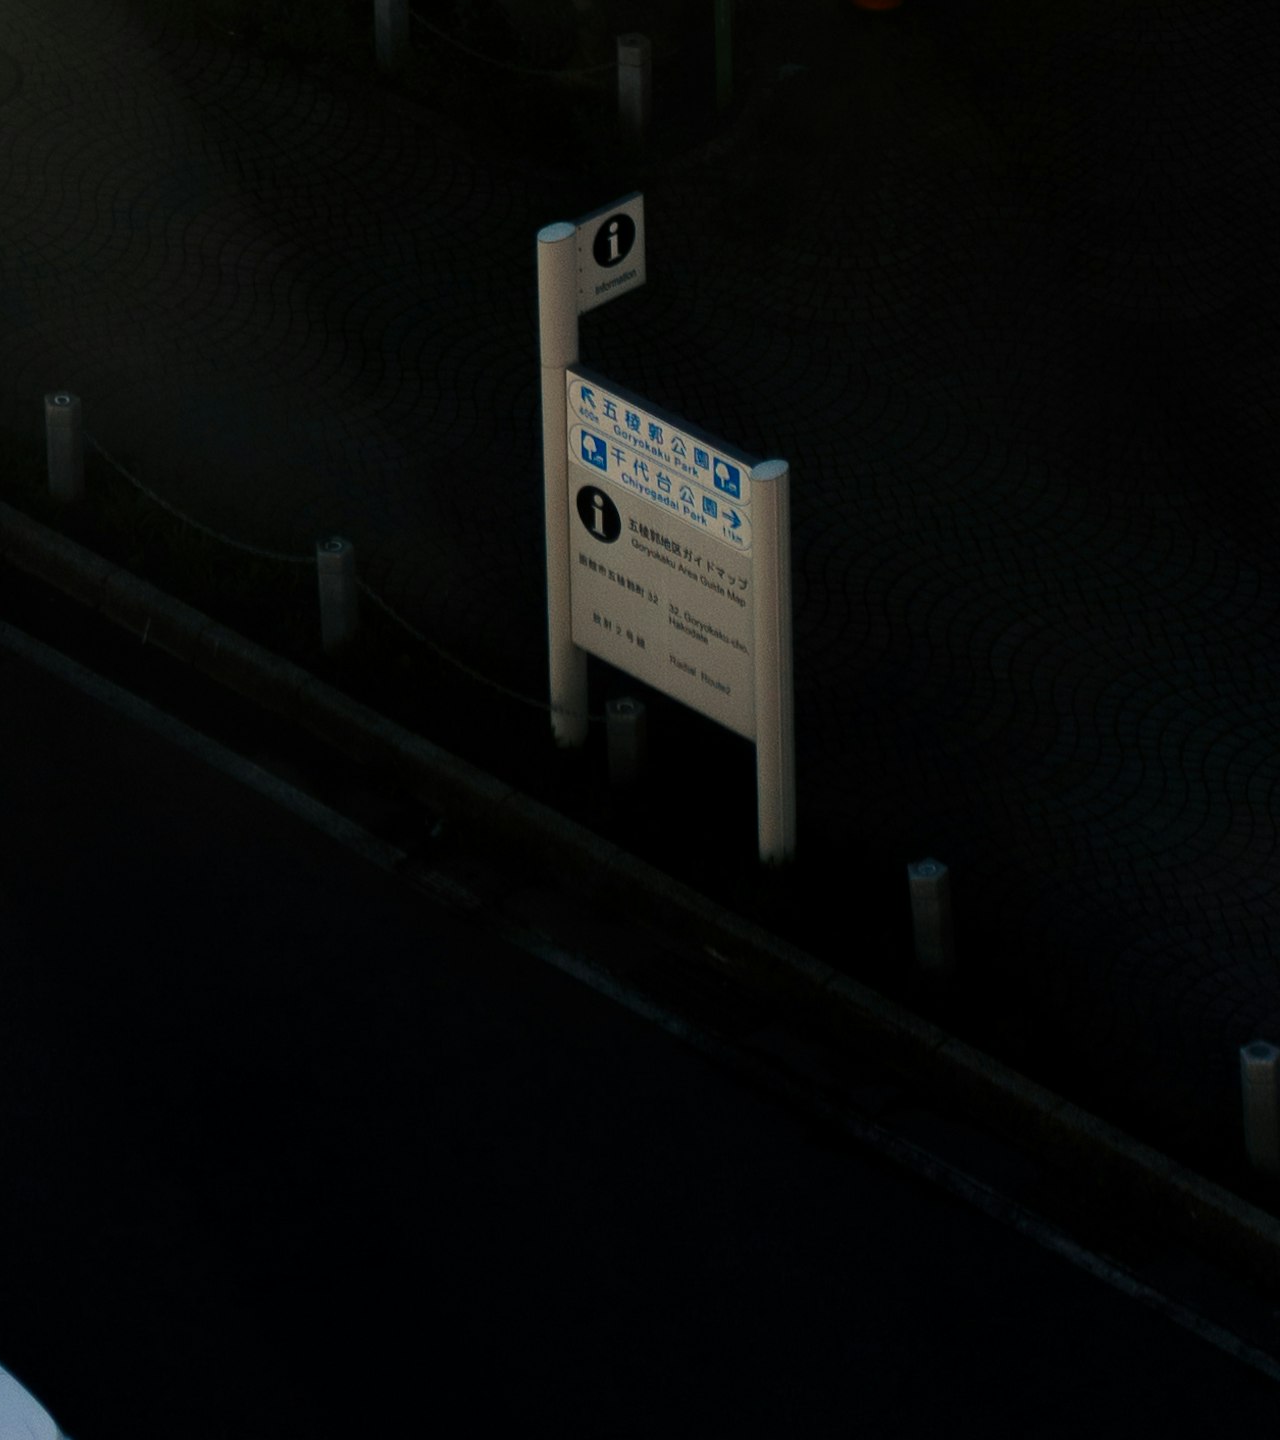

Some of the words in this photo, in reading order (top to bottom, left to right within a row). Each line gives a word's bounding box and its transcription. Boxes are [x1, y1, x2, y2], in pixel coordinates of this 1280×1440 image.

[595, 268, 638, 295] Information
[602, 397, 710, 471] 五稜郭公園
[613, 423, 671, 462] Goryokaku
[674, 456, 699, 478] Park
[610, 445, 718, 519] 千代台公園
[621, 471, 679, 511] Chiyogadai
[683, 505, 708, 526] Park
[628, 518, 748, 590] 五稜郭地区ガイドマップ
[631, 538, 676, 569] Goryokaku
[678, 563, 698, 582] Area
[700, 575, 725, 596] Guide
[727, 590, 747, 608] Map
